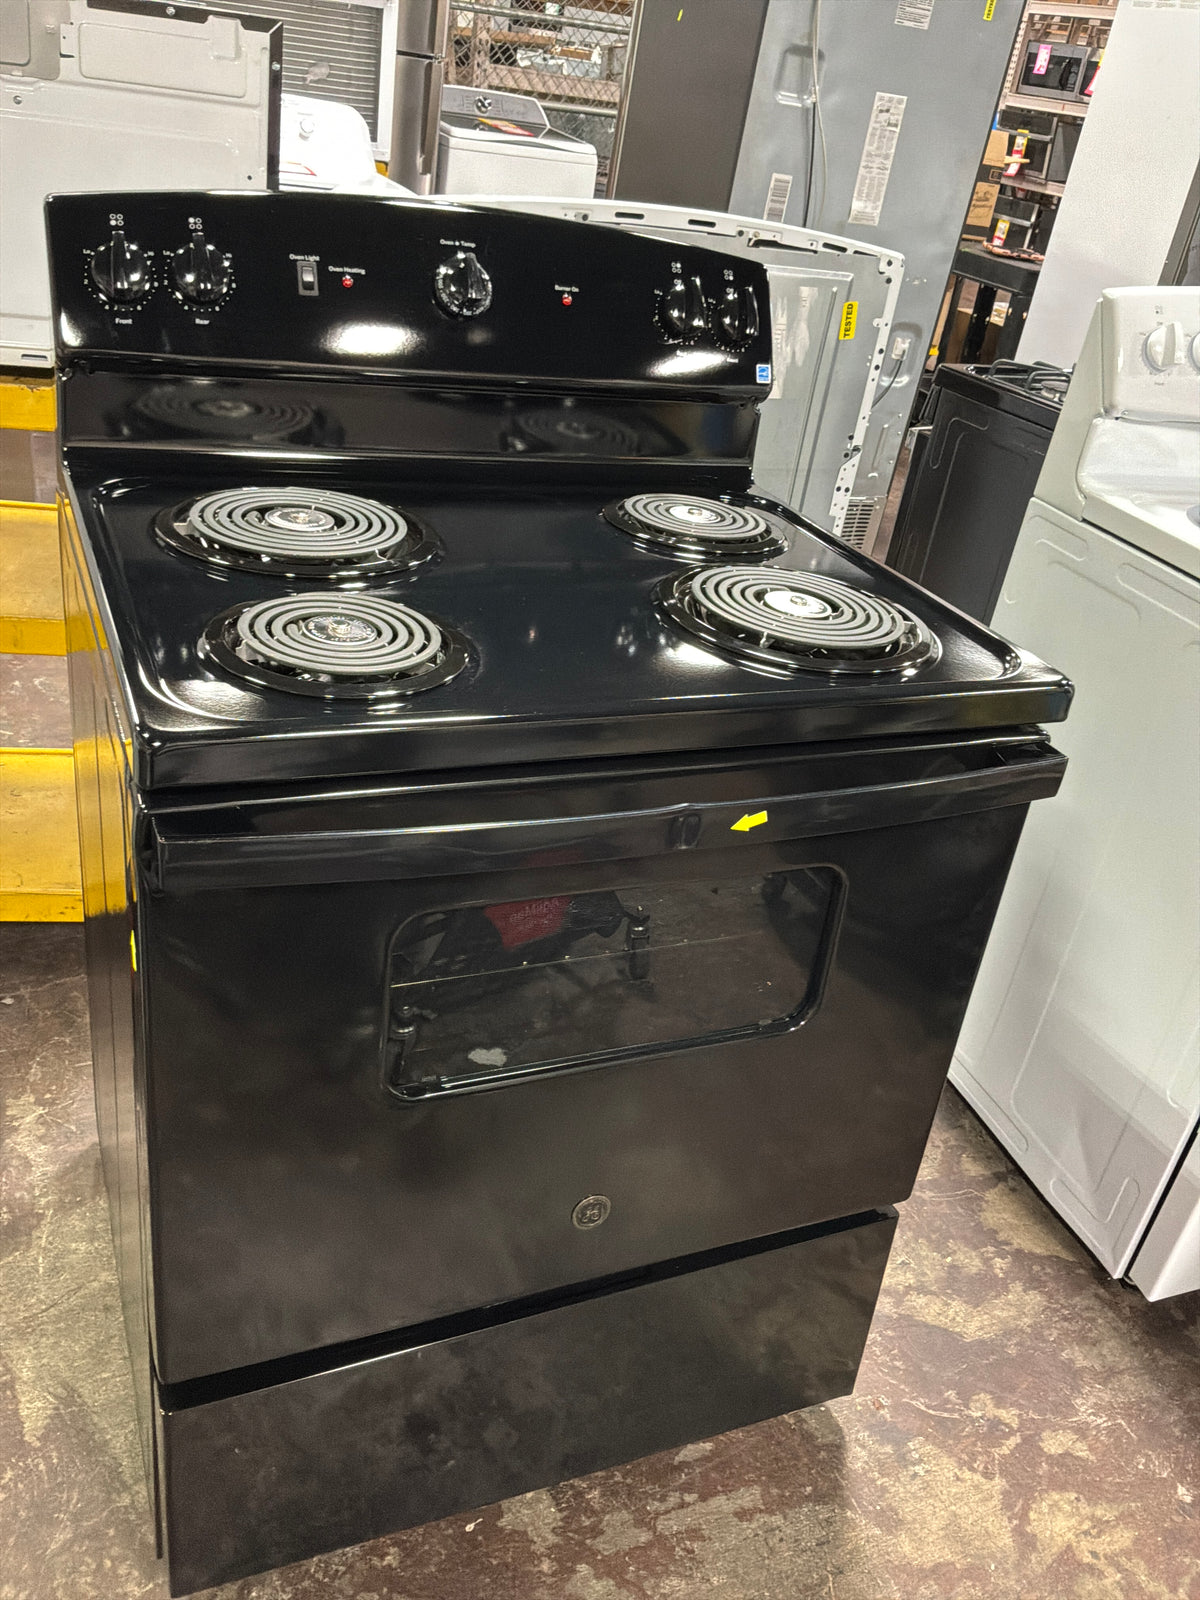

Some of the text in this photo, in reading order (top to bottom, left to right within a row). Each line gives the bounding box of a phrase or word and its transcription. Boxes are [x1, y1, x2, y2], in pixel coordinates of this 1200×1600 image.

[289, 253, 320, 262] Oven Light
[328, 265, 366, 275] Oven Heating
[114, 317, 134, 325] Front
[843, 303, 854, 338] TESTED
